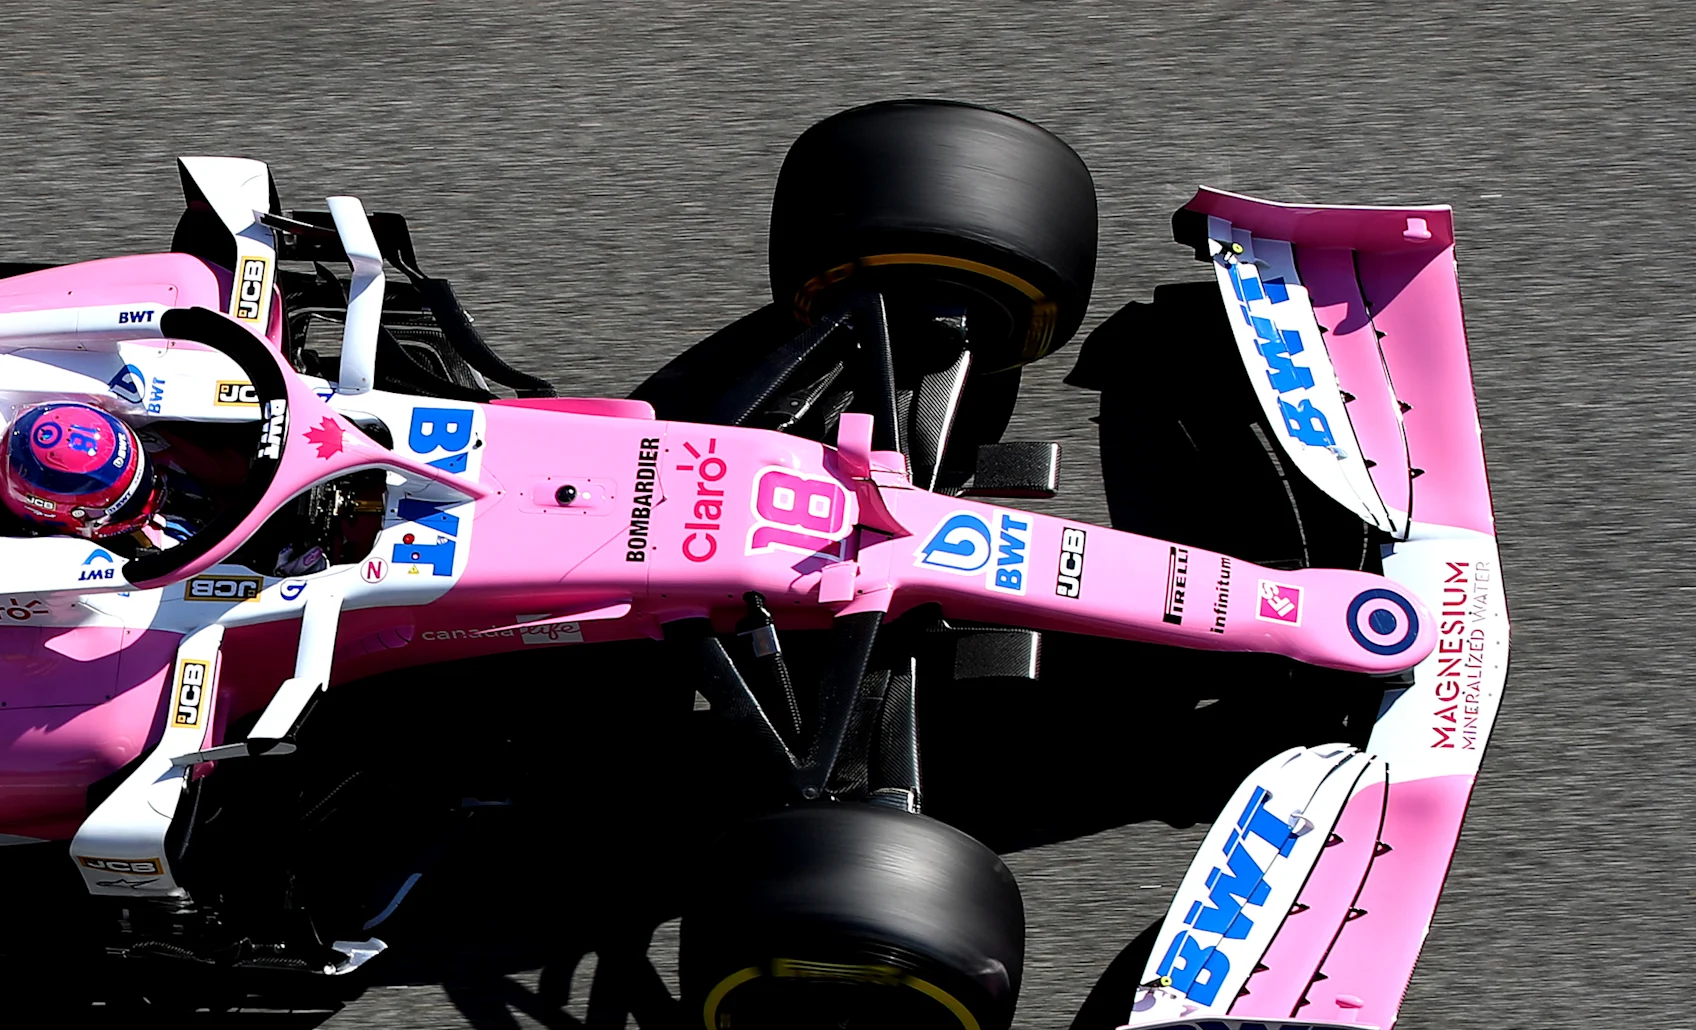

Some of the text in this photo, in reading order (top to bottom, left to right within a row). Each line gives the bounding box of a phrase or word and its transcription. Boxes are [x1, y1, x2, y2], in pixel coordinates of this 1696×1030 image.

[119, 310, 154, 323] BWT
[238, 260, 264, 318] JCB
[1227, 263, 1336, 448] BWT
[148, 377, 166, 414] BWT
[219, 384, 259, 402] JC
[257, 399, 287, 459] BWT
[626, 437, 660, 562] BOMBARDIER
[681, 456, 727, 563] Claro
[747, 465, 854, 562] 18
[78, 568, 115, 581] BWT
[192, 580, 257, 597] JCB
[995, 514, 1027, 590] BWT
[1057, 528, 1086, 598] JCB
[1163, 546, 1188, 625] PIRELLI
[1210, 557, 1231, 634] infinitum
[1431, 562, 1469, 749] MAGNESIUM
[1462, 561, 1491, 750] MINERALIZED WATER
[175, 663, 206, 725] JCB
[86, 859, 156, 873] JCB
[1156, 785, 1301, 1008] BWT
